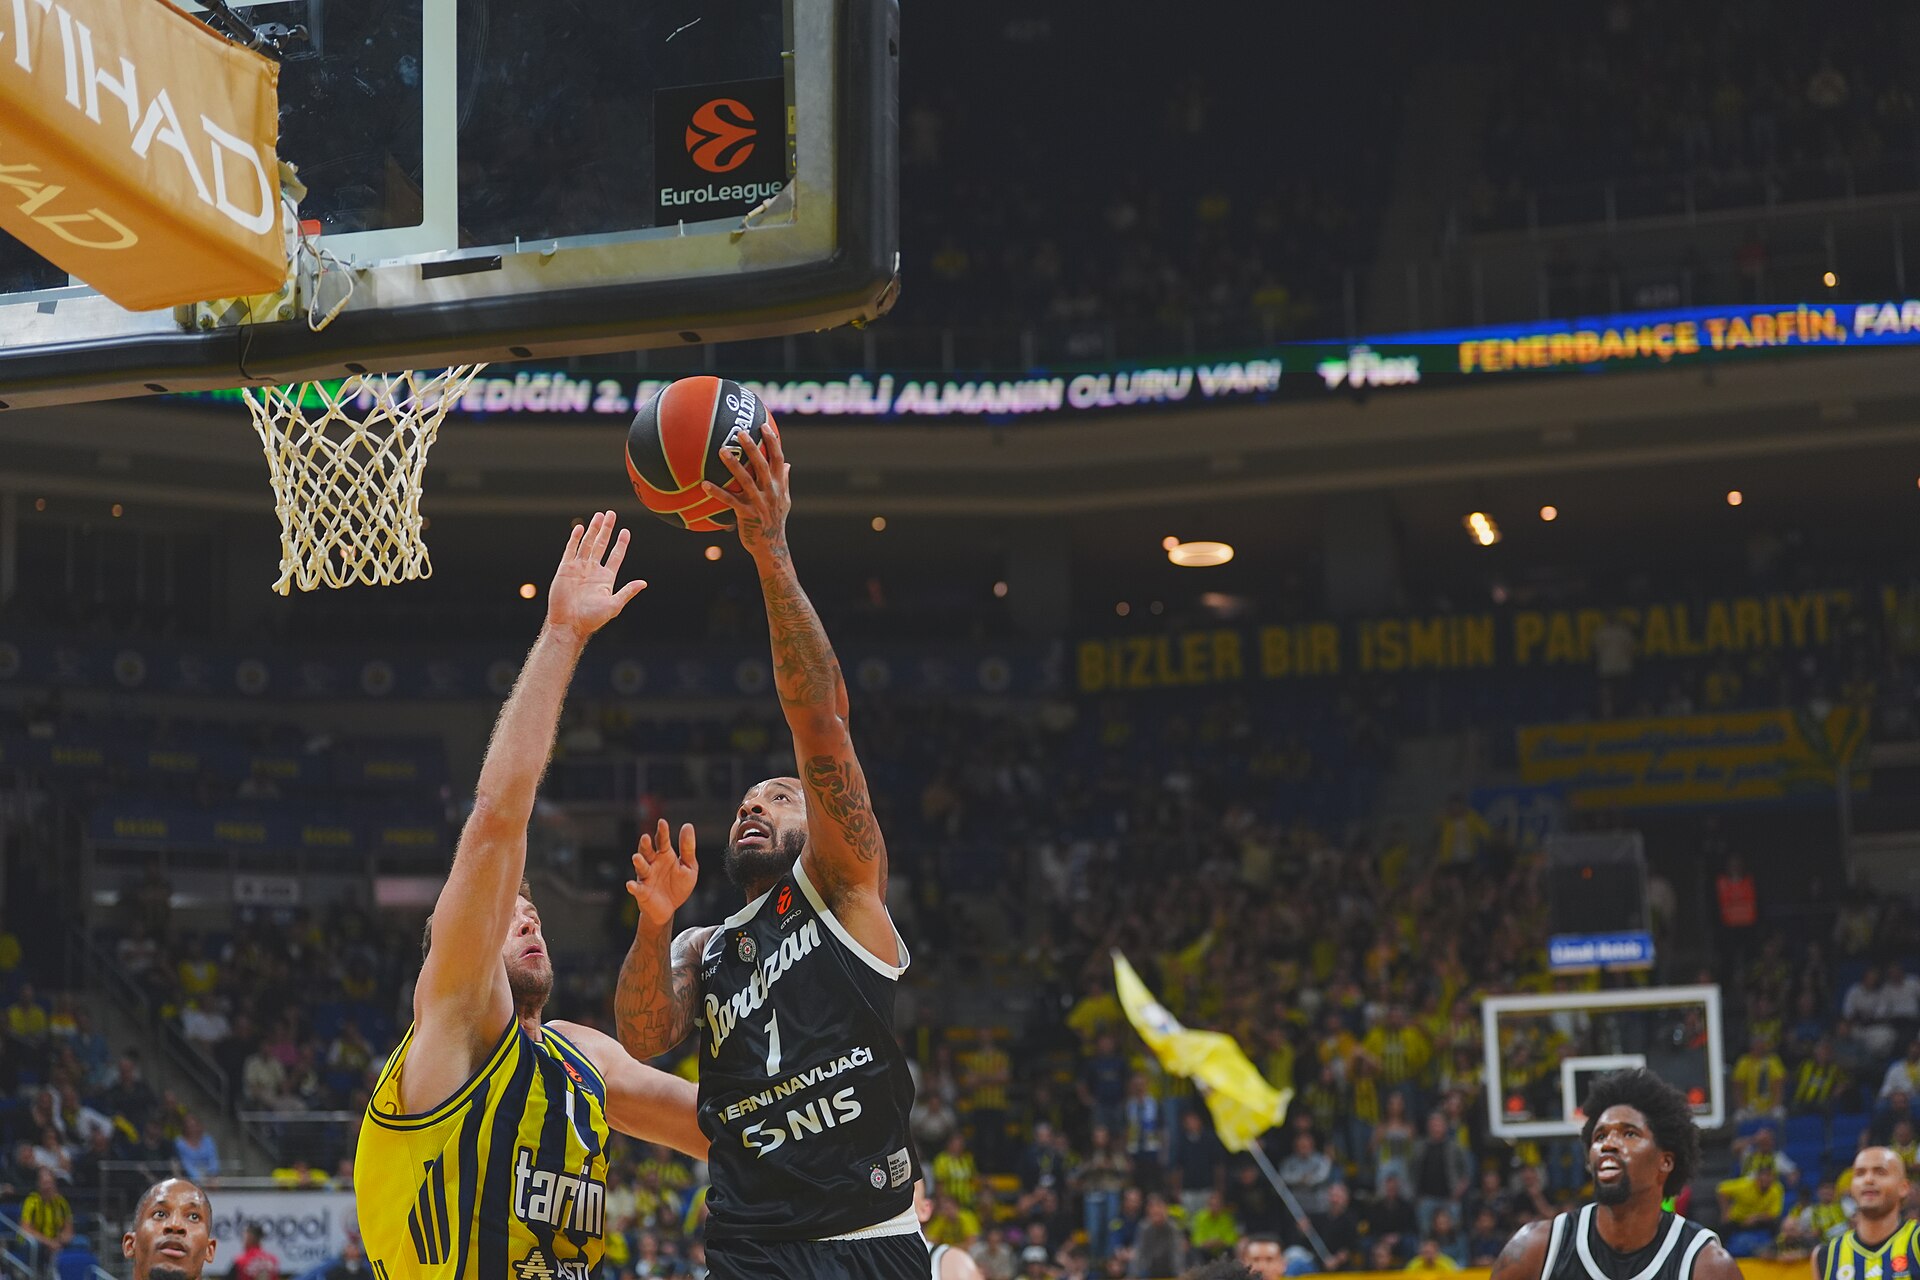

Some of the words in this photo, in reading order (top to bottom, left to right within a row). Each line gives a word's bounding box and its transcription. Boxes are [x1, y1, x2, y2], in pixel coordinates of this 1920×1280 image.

[0, 0, 274, 235] TIHAD
[661, 181, 783, 206] EuroLeague
[1458, 321, 1699, 373] FENERBAHÇE
[1066, 367, 1193, 409] OLURU
[1196, 358, 1281, 397] VAR!
[763, 1008, 781, 1078] 1
[718, 1088, 772, 1125] VERNI
[772, 1046, 874, 1101] NAVIJAČI
[786, 1086, 862, 1141] NIS
